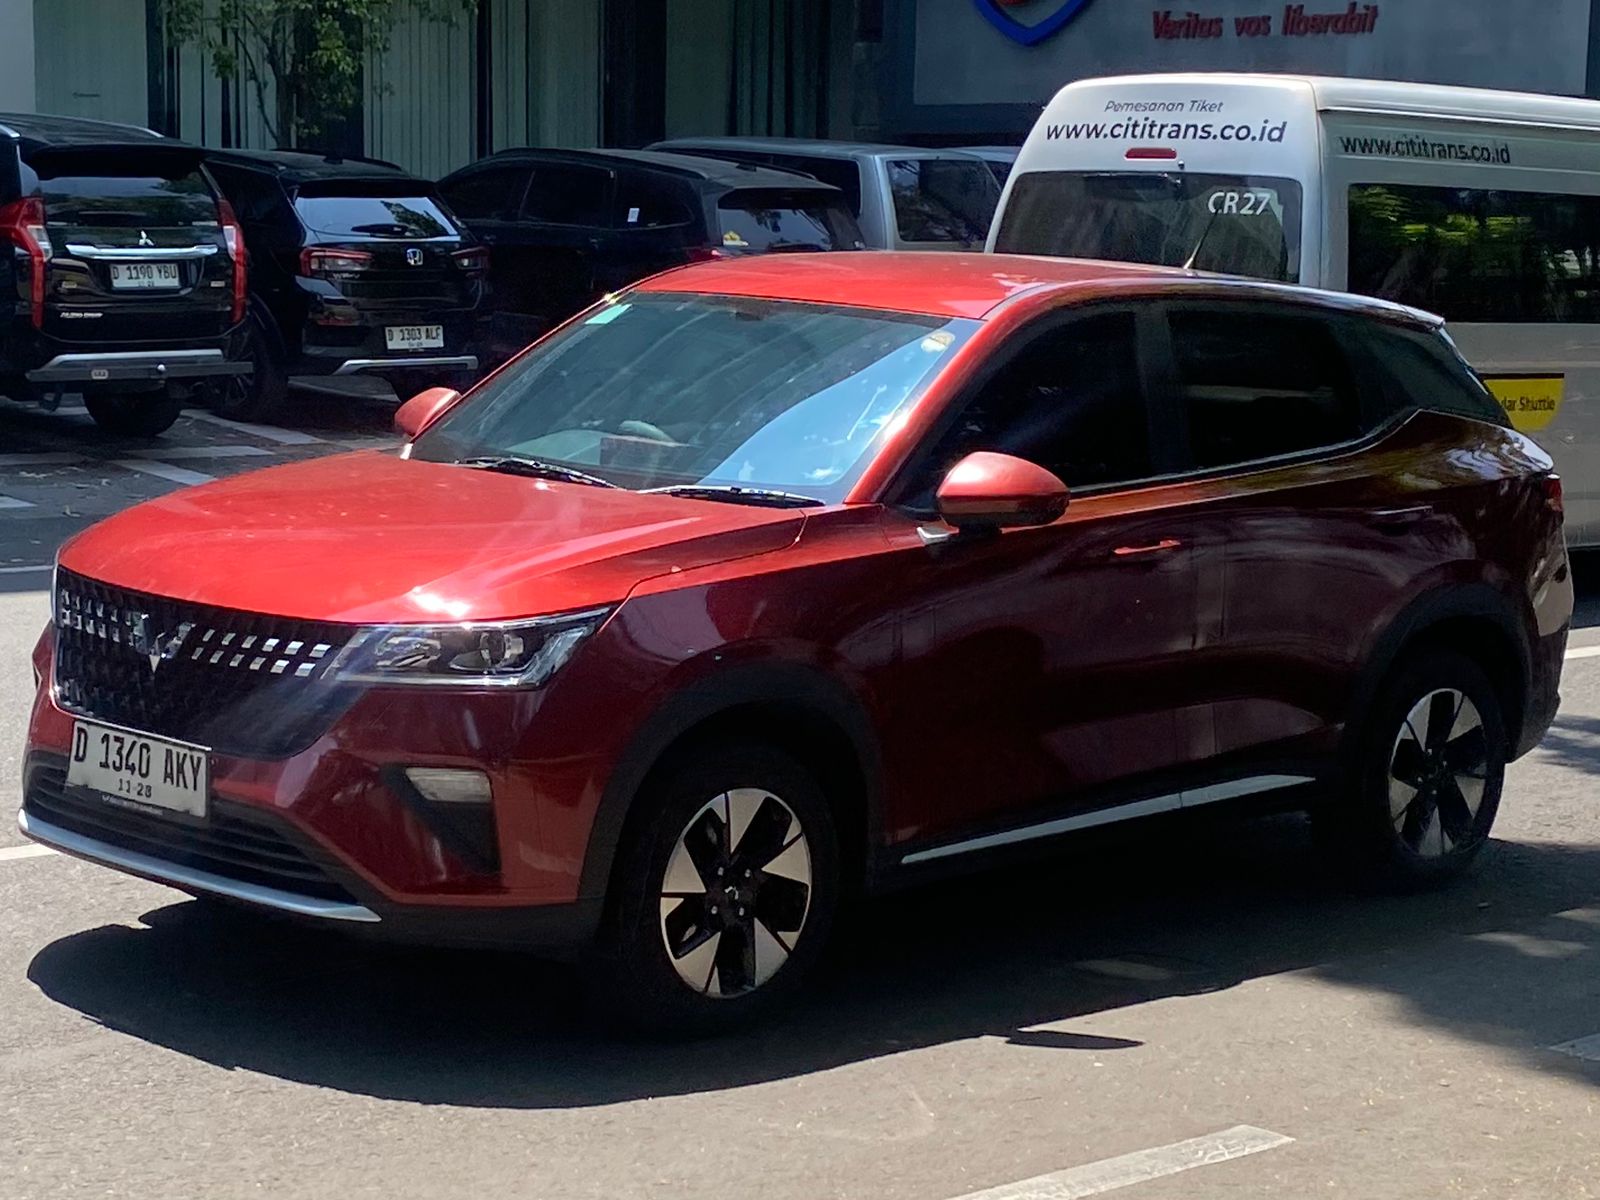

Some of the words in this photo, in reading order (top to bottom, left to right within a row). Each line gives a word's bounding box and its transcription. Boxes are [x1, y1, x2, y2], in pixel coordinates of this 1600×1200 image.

[1152, 10, 1223, 39] Veritas
[1234, 15, 1271, 37] vos
[1105, 100, 1184, 112] Pemesanan
[1189, 100, 1224, 113] Tiket
[1046, 117, 1287, 143] www.cititrans.co.id
[1340, 134, 1511, 164] www.cititrans.co.id
[1208, 191, 1271, 216] CR27
[112, 266, 120, 280] D
[126, 265, 153, 280] 1190
[387, 328, 394, 341] D
[1519, 396, 1556, 411] Shuttle
[74, 726, 88, 762] D
[99, 733, 151, 779] 1340
[163, 748, 202, 792] AKY
